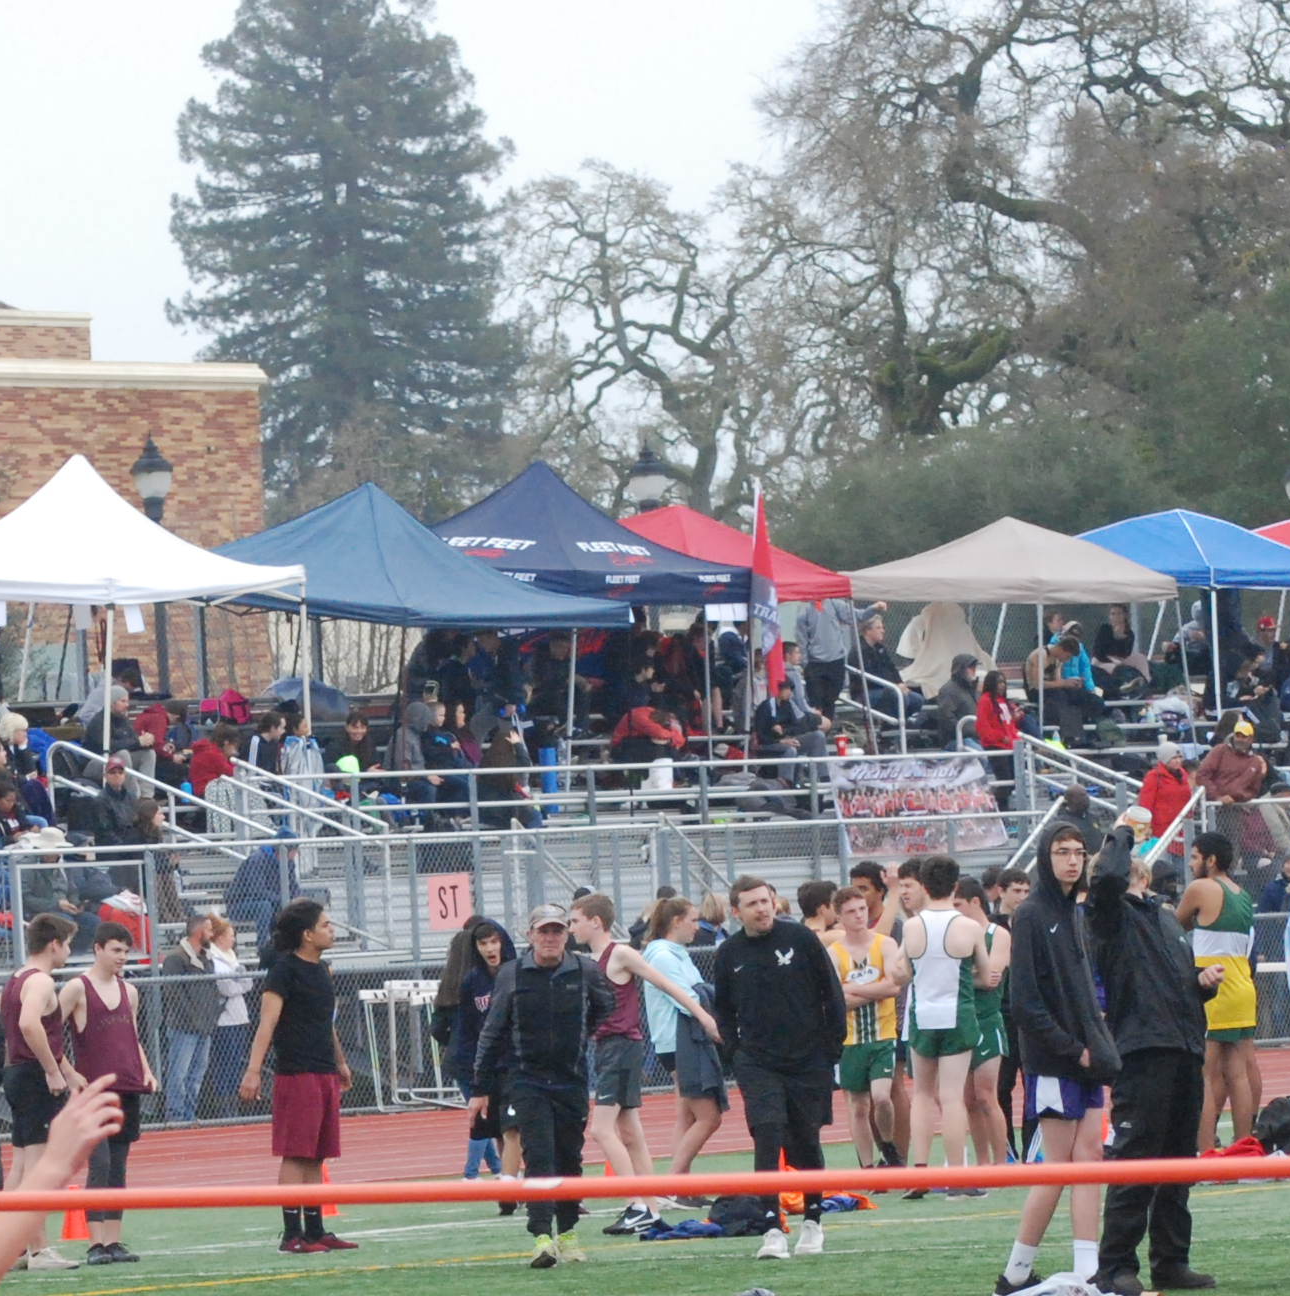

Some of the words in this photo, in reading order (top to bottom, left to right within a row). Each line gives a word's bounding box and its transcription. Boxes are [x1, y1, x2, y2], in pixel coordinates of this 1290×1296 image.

[483, 537, 537, 550] FEET
[575, 541, 619, 553] FLEET
[616, 542, 651, 556] FEET
[753, 602, 780, 623] TRA
[903, 763, 960, 779] NAION
[438, 885, 459, 919] ST
